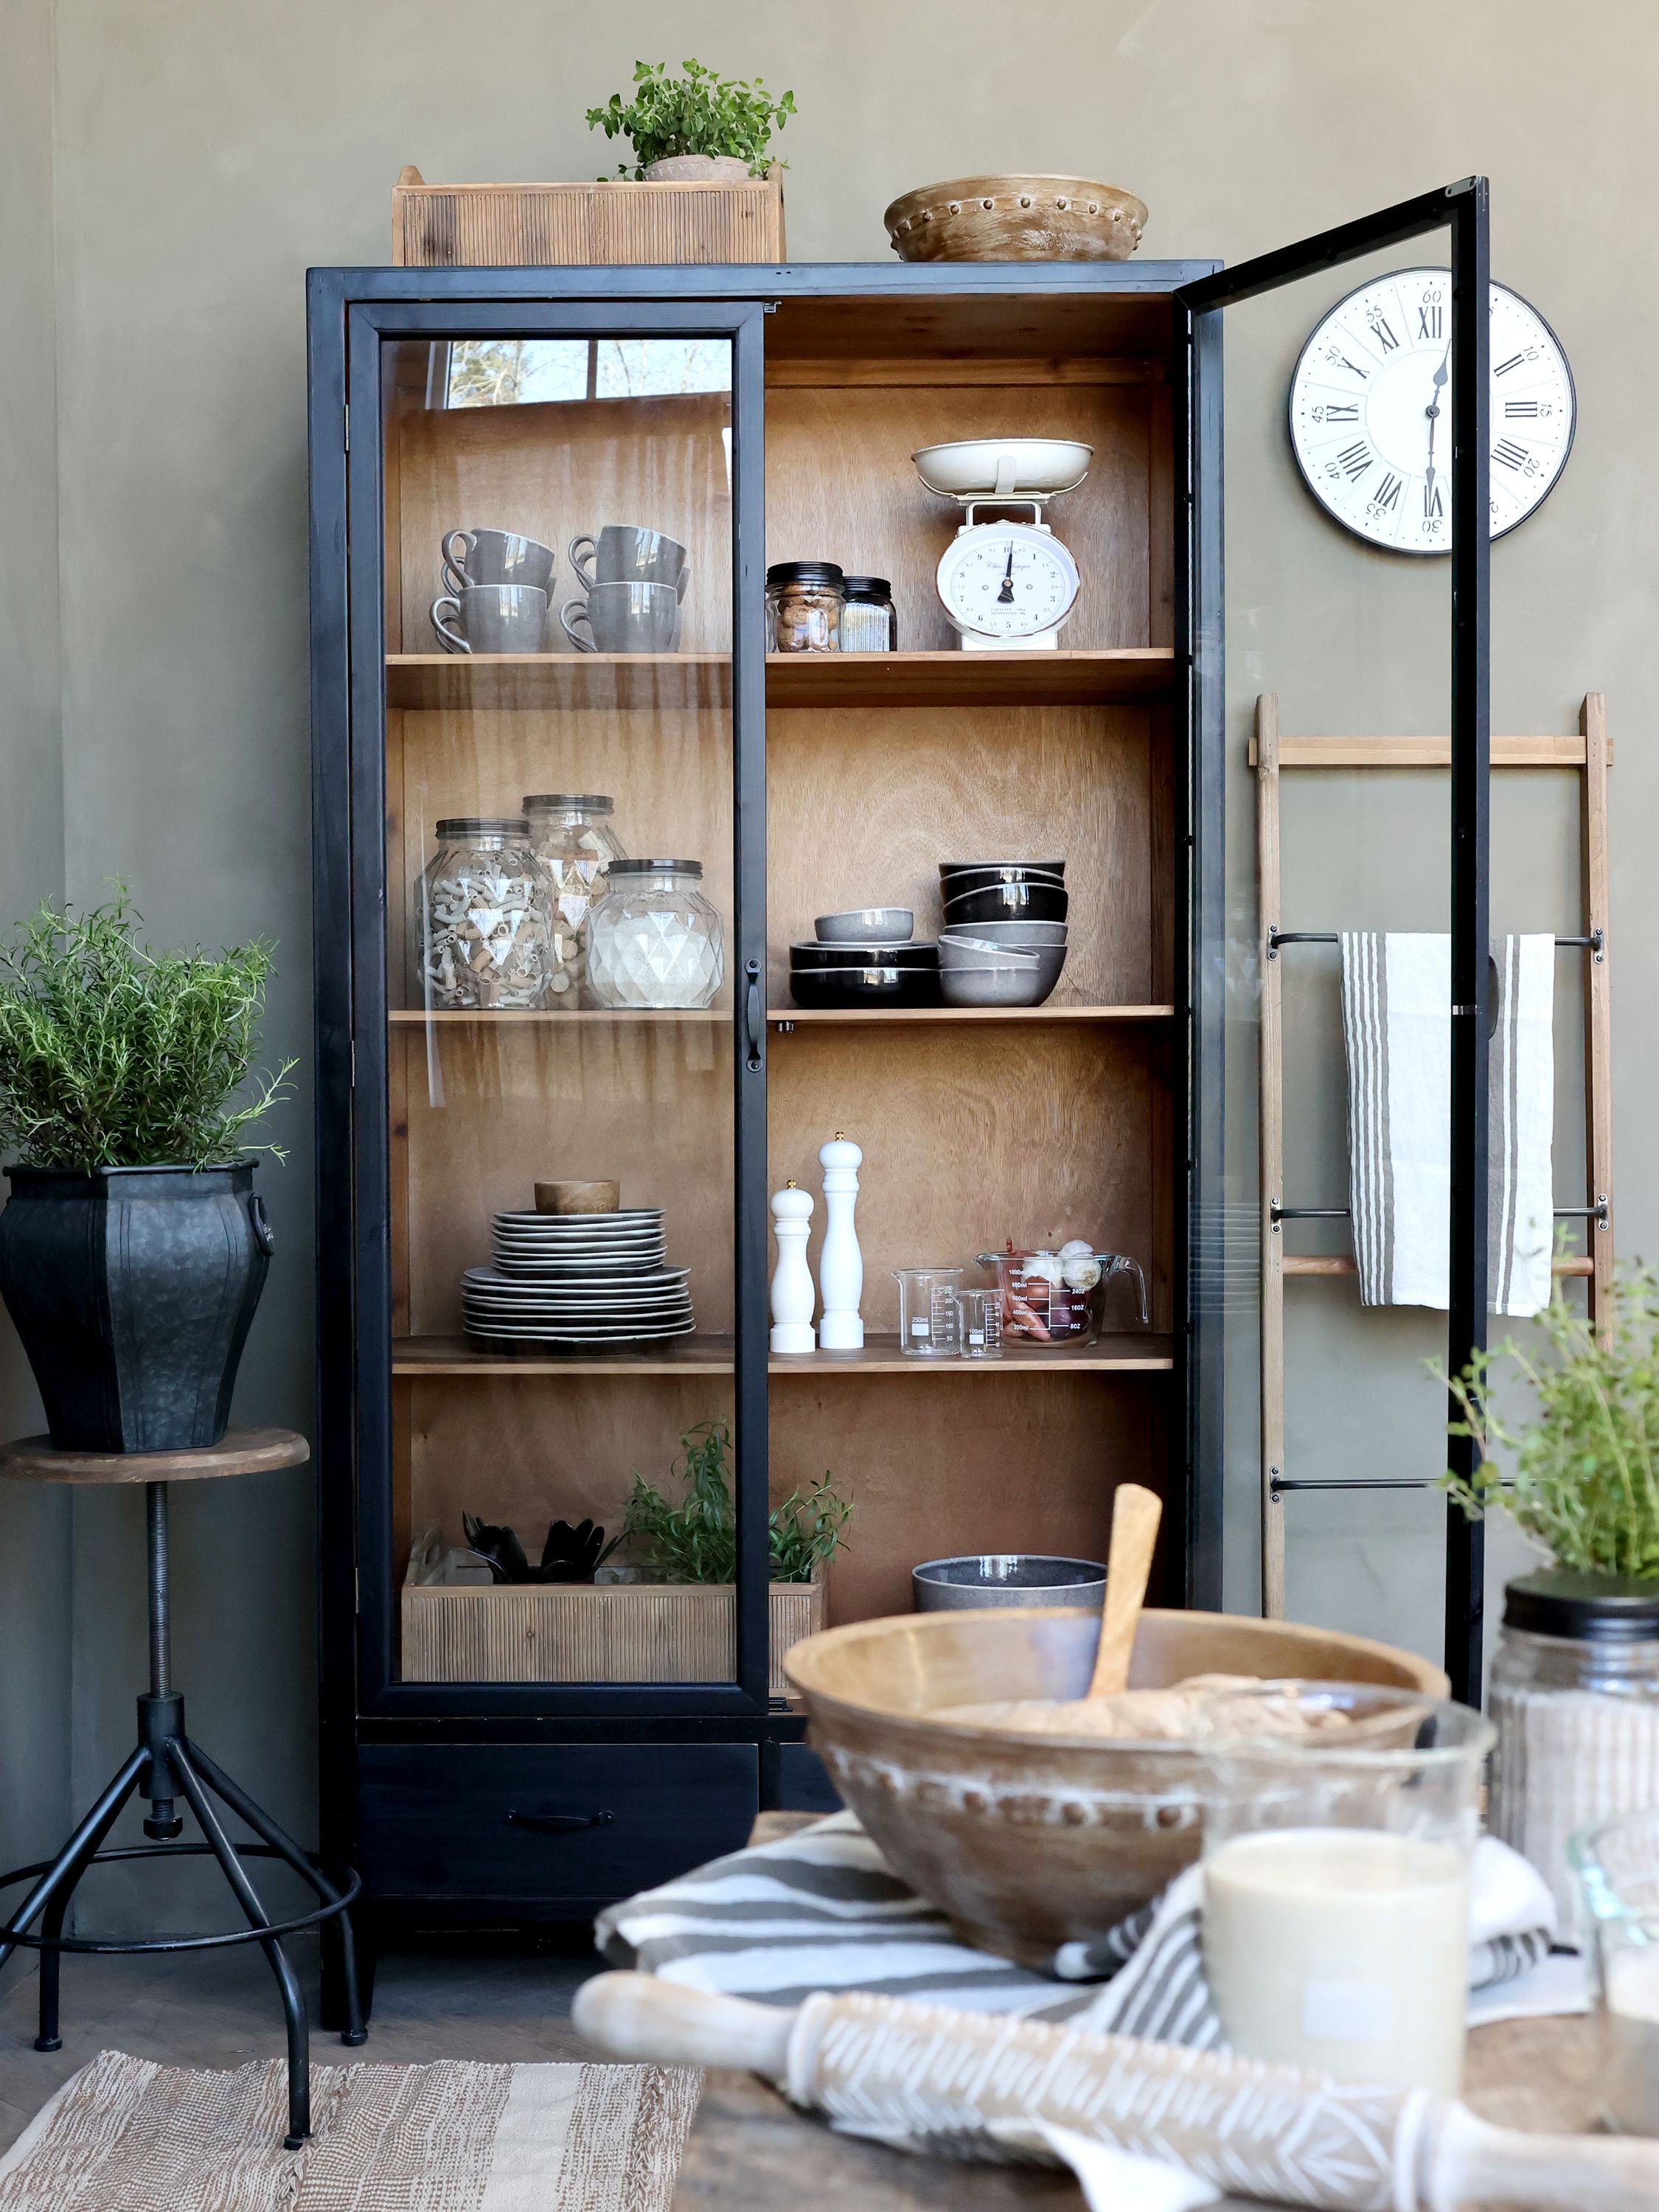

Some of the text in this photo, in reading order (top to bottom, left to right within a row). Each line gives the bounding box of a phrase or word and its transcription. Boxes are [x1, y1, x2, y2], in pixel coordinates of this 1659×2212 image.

[1422, 290, 1441, 304] 60
[1365, 305, 1382, 323] 55
[1418, 306, 1442, 339] XII
[1370, 318, 1400, 355] XI
[1325, 344, 1341, 366] 50
[1523, 346, 1540, 361] 10
[1337, 356, 1371, 379] X
[1493, 352, 1526, 378] II
[1311, 406, 1324, 424] 45
[1326, 403, 1359, 422] IX
[1505, 400, 1538, 418] III
[1540, 403, 1552, 417] 15
[1337, 440, 1374, 484] VIII
[1490, 438, 1529, 471] IIII
[1324, 461, 1341, 481] 40
[1523, 458, 1540, 478] 20
[1373, 472, 1402, 511] VII
[1424, 484, 1444, 517] VI
[1365, 502, 1387, 521] 35
[1422, 519, 1442, 533] 30
